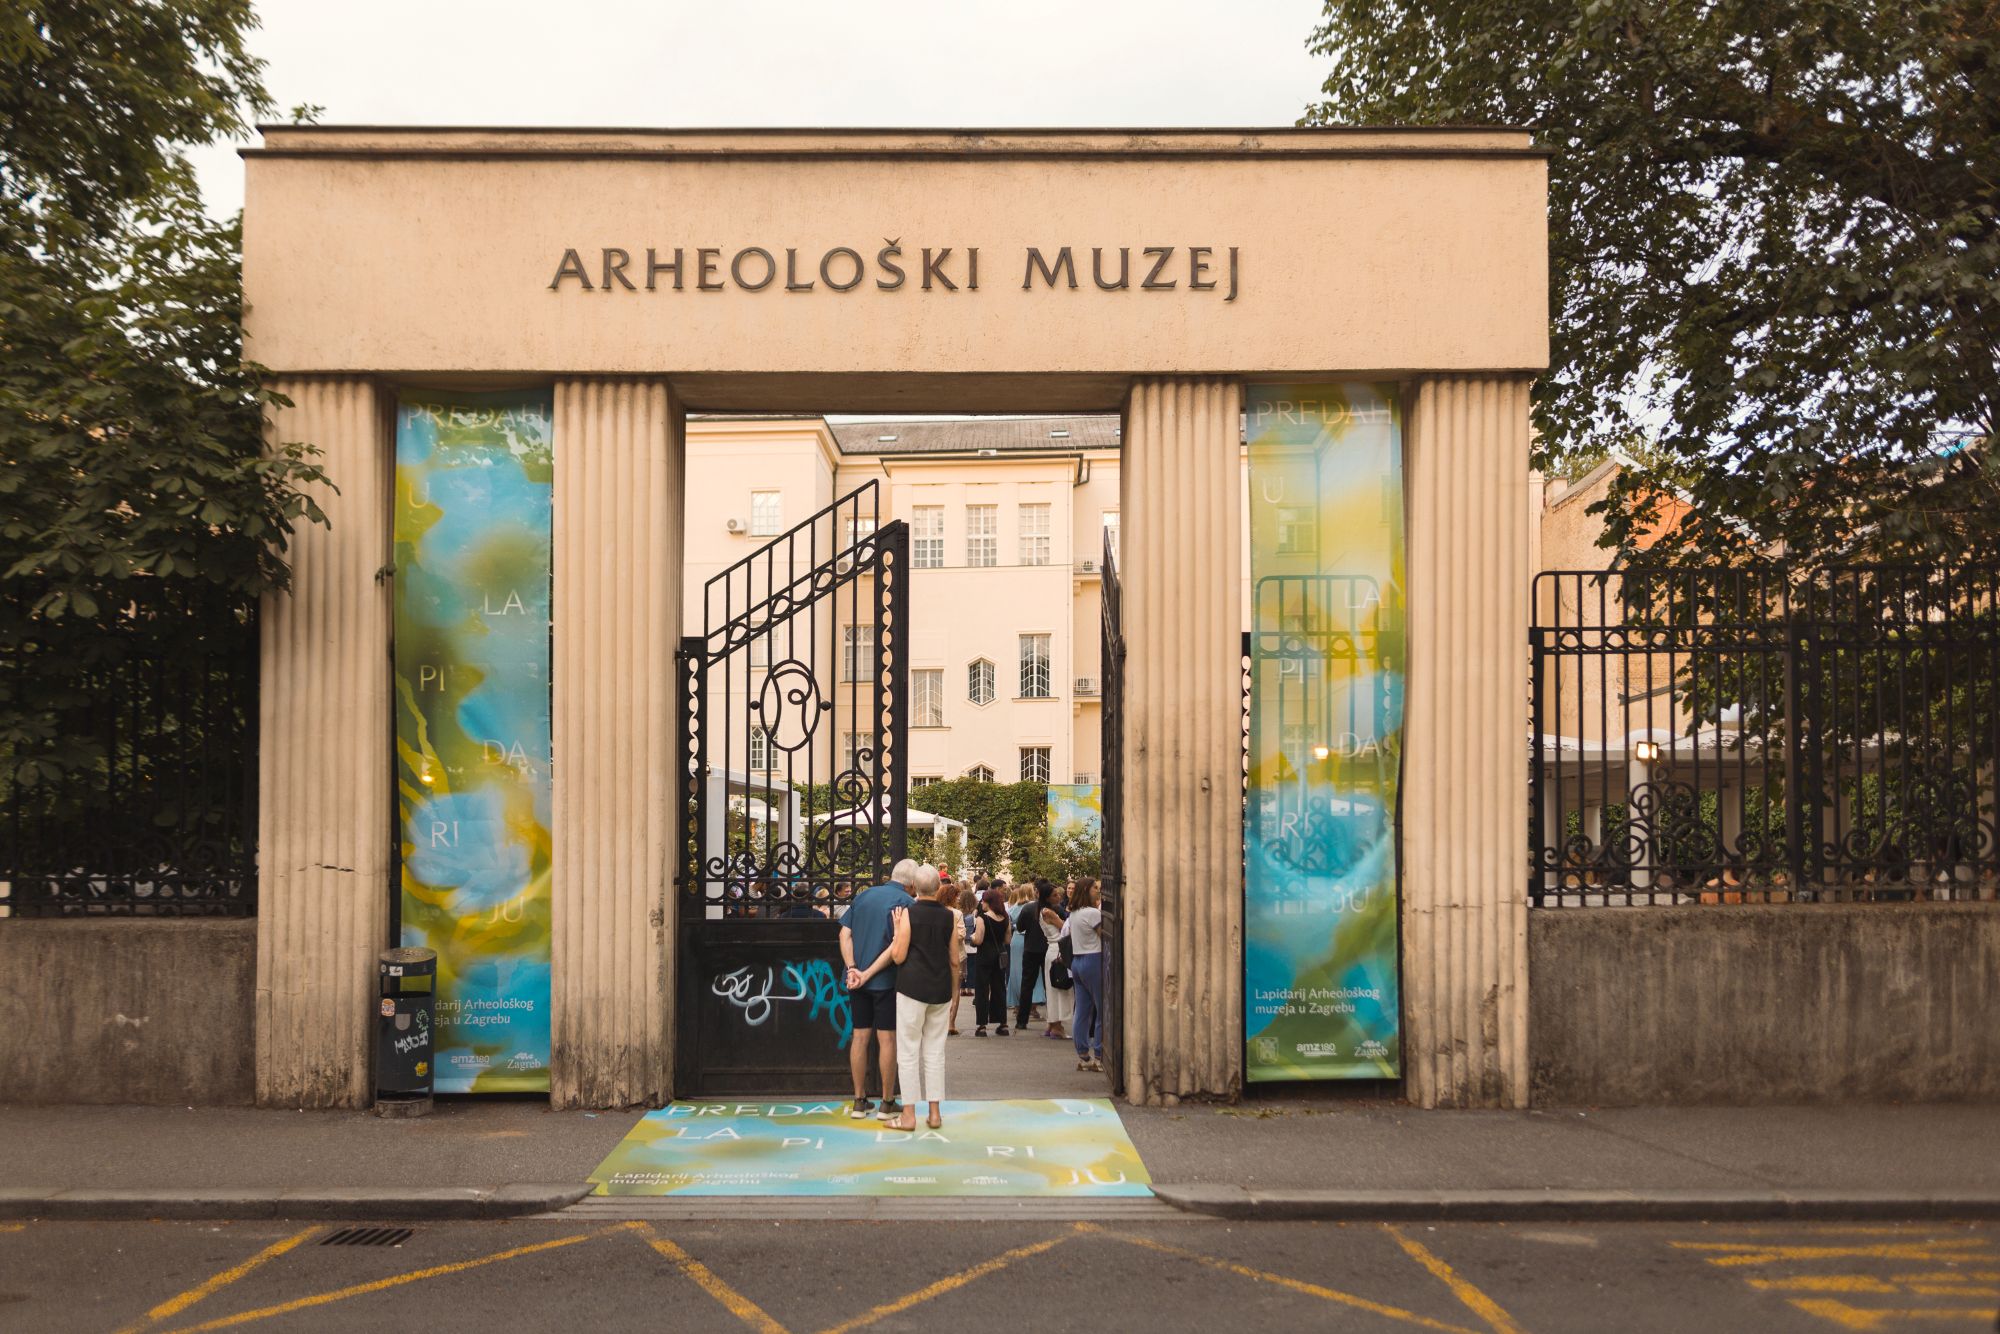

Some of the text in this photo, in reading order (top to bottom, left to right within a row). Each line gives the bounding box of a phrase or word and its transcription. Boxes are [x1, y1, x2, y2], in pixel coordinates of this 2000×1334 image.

[547, 236, 1241, 302] ARHEOLOŠKI MUZEJ
[1256, 399, 1393, 427] PREDAH
[408, 482, 431, 509] U
[1262, 476, 1284, 504] U
[484, 588, 526, 616] LA
[1344, 582, 1381, 609] LA
[419, 664, 445, 692] PI
[1278, 657, 1304, 684] PI
[483, 739, 528, 765] DA
[1338, 732, 1381, 759] DA
[431, 821, 460, 848] RI
[1280, 811, 1310, 838] RI
[485, 895, 525, 924] JU
[1331, 886, 1370, 914] JU
[434, 998, 535, 1013] darij Arheološkog
[1255, 987, 1380, 1001] Lapidarij Arheološkog
[434, 1013, 511, 1027] eja u Zagrebu
[1255, 1002, 1356, 1016] muzeja u Zagrebu
[507, 1058, 541, 1071] Zagreb
[1354, 1046, 1389, 1059] Zagreb
[675, 1126, 742, 1140] LA
[781, 1137, 824, 1150] PI
[875, 1129, 950, 1143] DA
[986, 1145, 1035, 1158] RI
[613, 1172, 689, 1180] Lapidarij
[1067, 1167, 1126, 1185] JU
